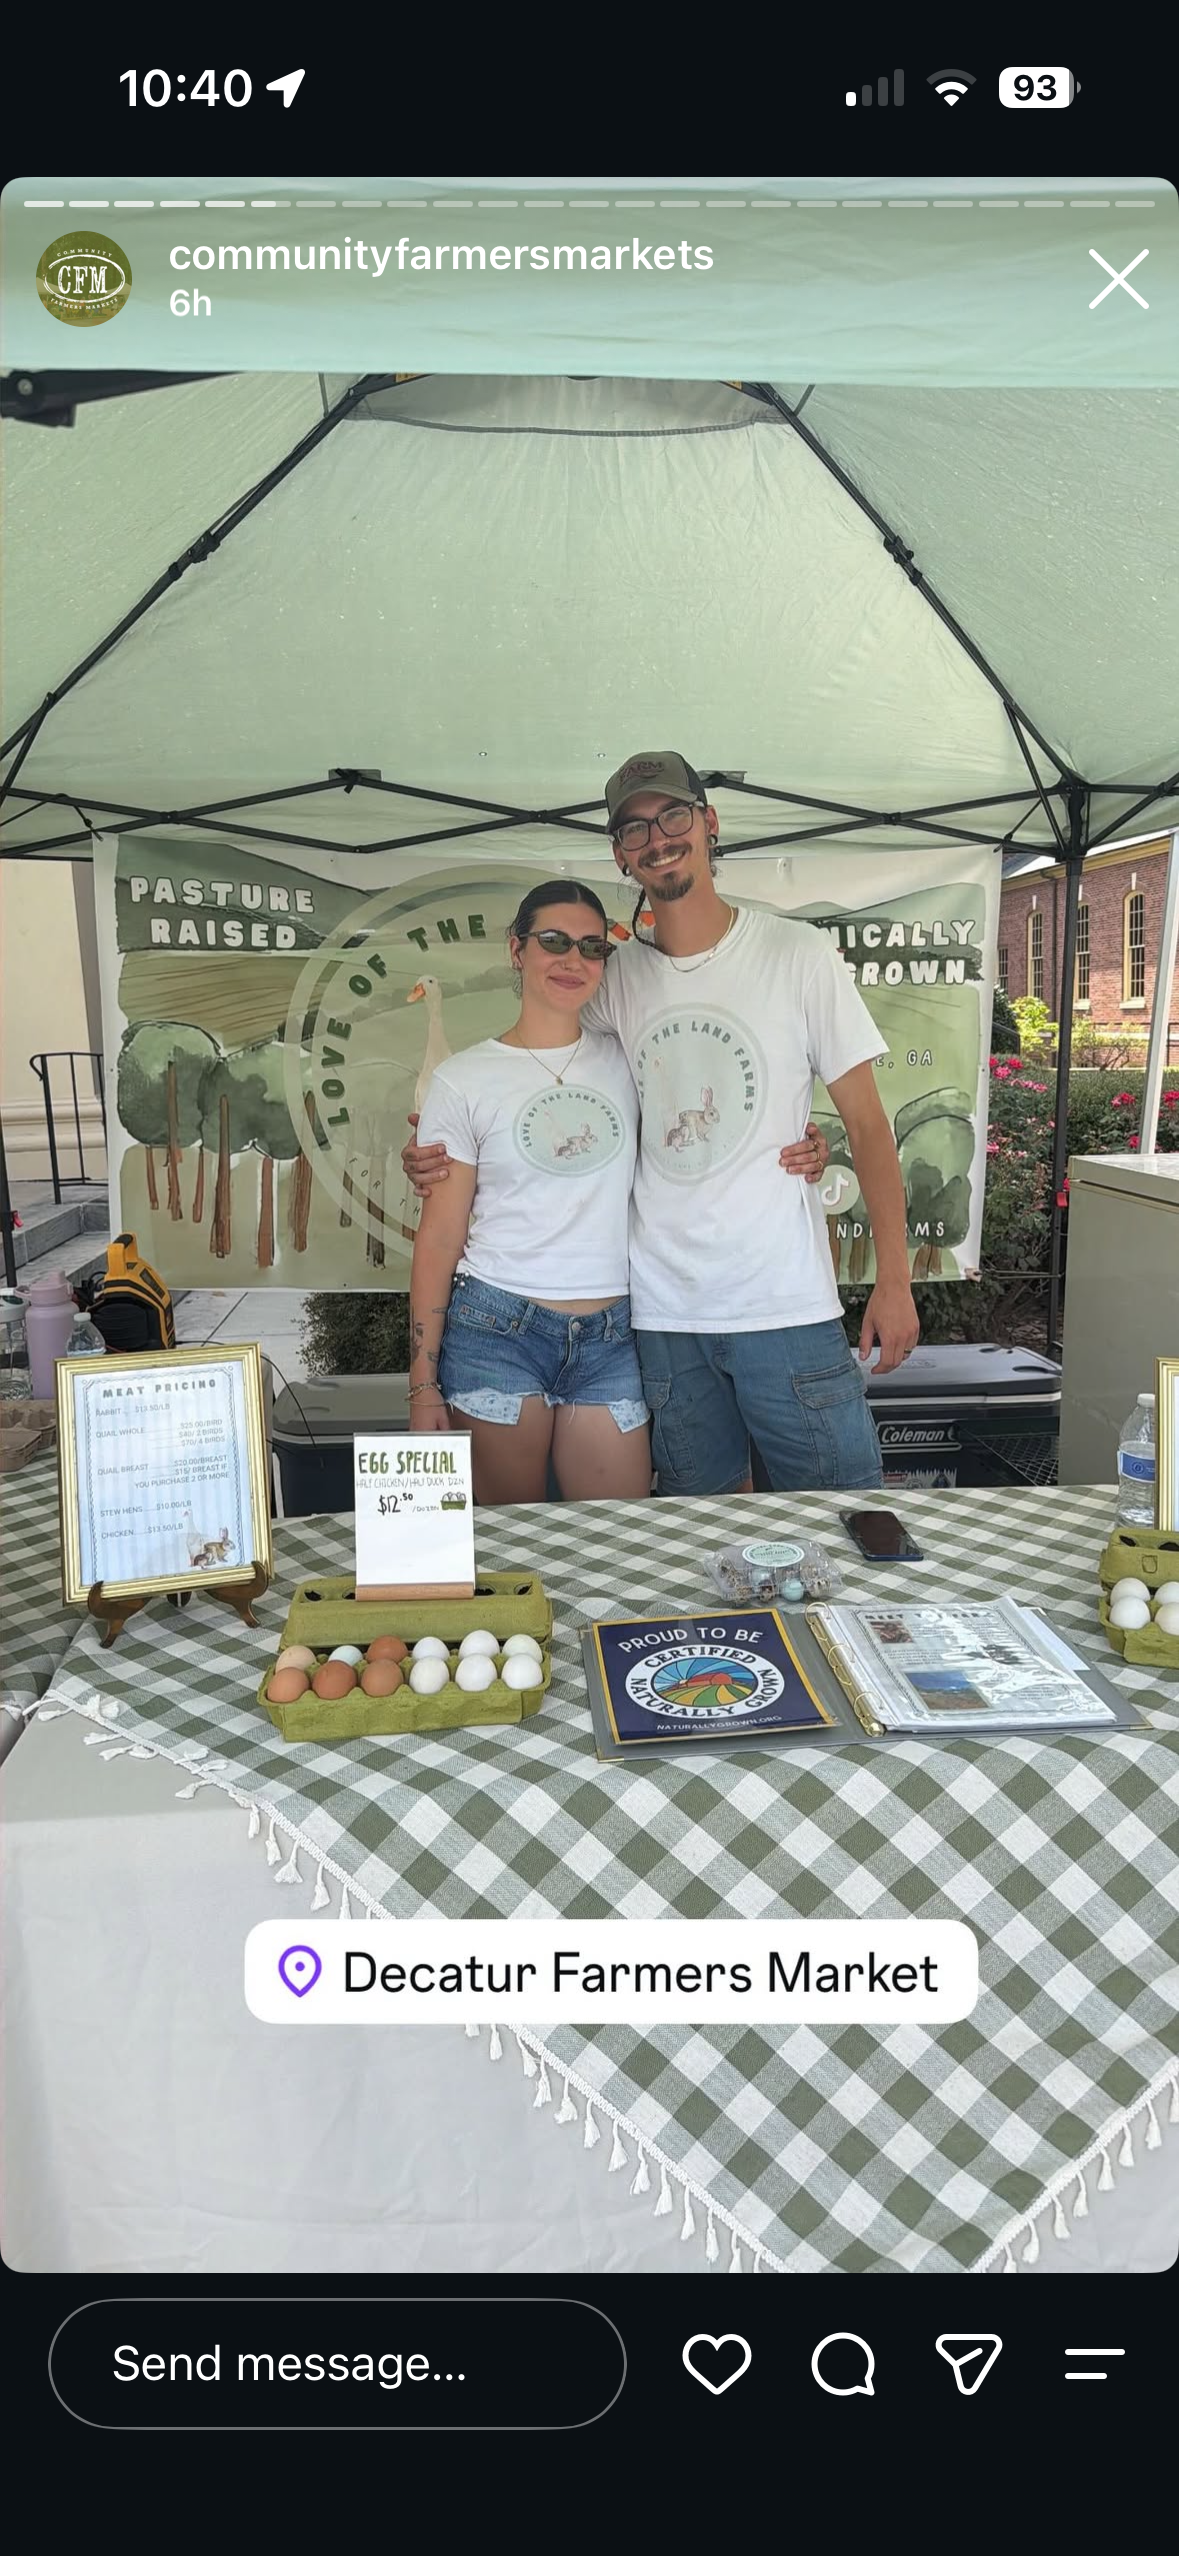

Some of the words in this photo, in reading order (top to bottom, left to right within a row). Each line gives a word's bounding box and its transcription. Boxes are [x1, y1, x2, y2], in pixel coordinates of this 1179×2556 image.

[130, 875, 315, 914] PASTURE
[150, 918, 297, 949] RAISED
[321, 1017, 352, 1127] LOVE
[348, 953, 388, 998] OF
[406, 914, 487, 951] THE
[637, 1049, 648, 1070] OF
[652, 1022, 680, 1045] THE
[691, 1020, 732, 1044] LAND
[734, 1047, 755, 1112] FARMS
[906, 1049, 933, 1066] GA
[522, 1122, 533, 1148] LOVE
[528, 1106, 538, 1118] OF
[541, 1093, 562, 1105] THE
[102, 1386, 145, 1399] MEAT
[155, 1379, 217, 1393] PRICING
[96, 1430, 118, 1438] QUAIL
[119, 1427, 146, 1436] WHOLE
[202, 1427, 224, 1436] BIRDS
[204, 1436, 225, 1444] BIRDS
[881, 1426, 945, 1443] Coleman
[97, 1467, 119, 1476] QUAIL
[120, 1464, 149, 1473] BREAST
[192, 1465, 220, 1474] BREAST
[358, 1451, 390, 1475] EGG
[396, 1450, 457, 1475] SPECIAL
[135, 1481, 149, 1489] YOU
[151, 1476, 190, 1487] PURCHASE
[197, 1474, 208, 1482] OR
[209, 1472, 229, 1480] MORE
[426, 1477, 445, 1487] DUCK
[100, 1509, 121, 1517] STEW
[122, 1506, 143, 1514] HENS
[101, 1529, 134, 1540] CHICKEN
[617, 1628, 688, 1653] PROUD
[697, 1627, 727, 1640] TO
[734, 1629, 764, 1644] BE
[644, 1646, 757, 1669] CERTIFIED
[631, 1677, 735, 1717] NATURALLY
[744, 1668, 780, 1708] GROWN
[656, 1715, 783, 1731] NATURALLYGROWN.ORG
